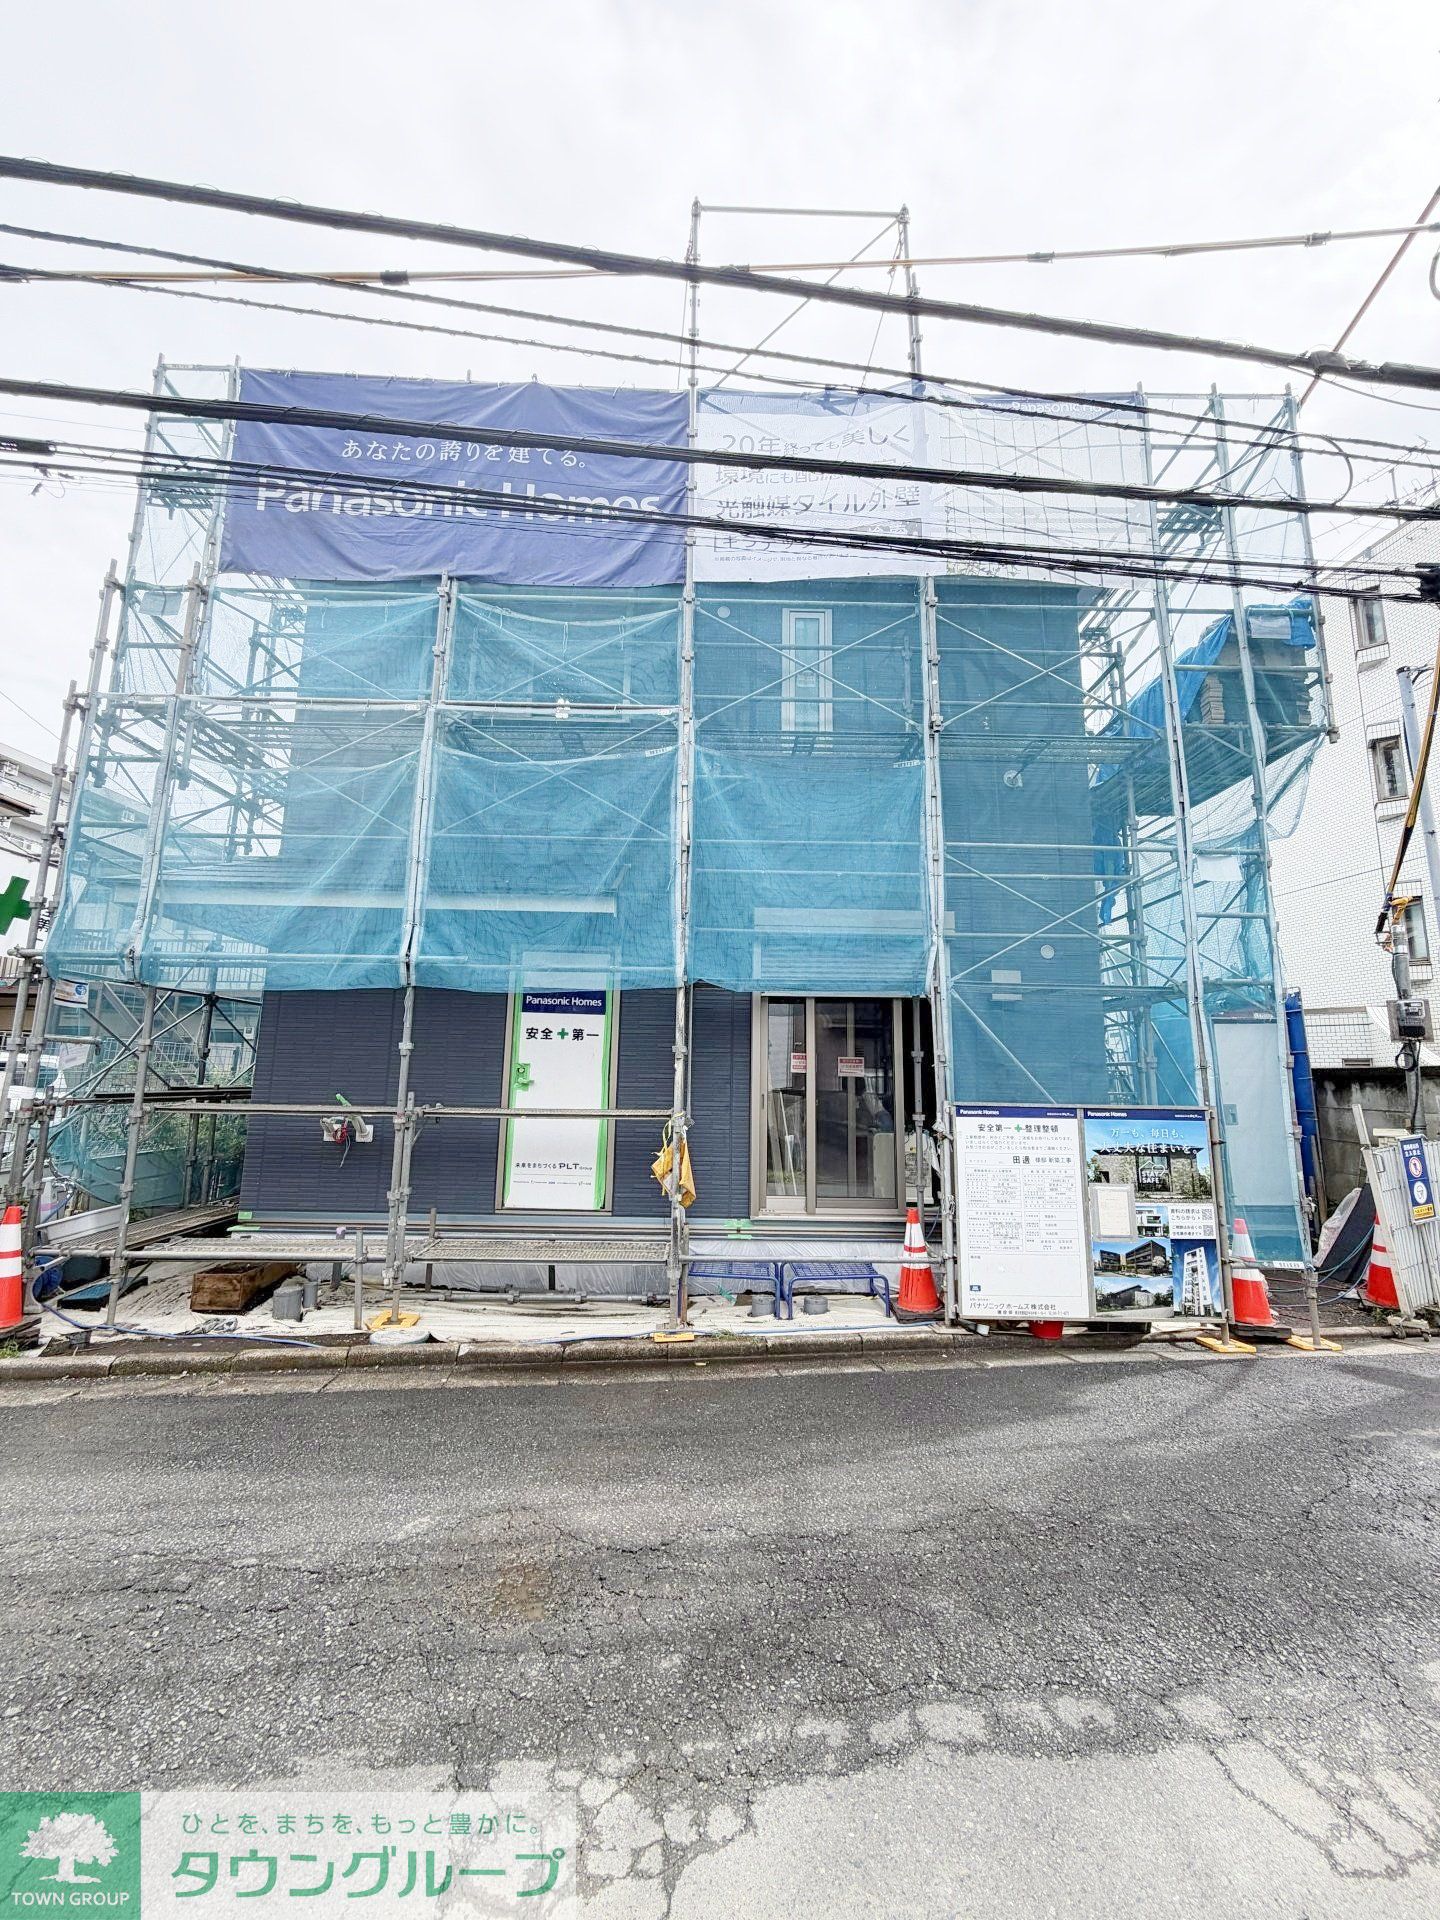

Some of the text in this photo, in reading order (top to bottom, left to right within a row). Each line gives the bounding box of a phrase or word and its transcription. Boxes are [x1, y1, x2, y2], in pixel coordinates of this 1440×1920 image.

[342, 439, 586, 469] あなたの誇りを建てる。
[256, 476, 488, 518] Panasonic
[716, 485, 921, 519] 光触媒タイル外壁
[526, 995, 602, 1007] Panasonic Homes
[525, 1027, 600, 1041] 安全 第一
[977, 1124, 1012, 1133] 安全第一
[558, 1162, 580, 1170] PLT
[1141, 1170, 1159, 1178] STAY
